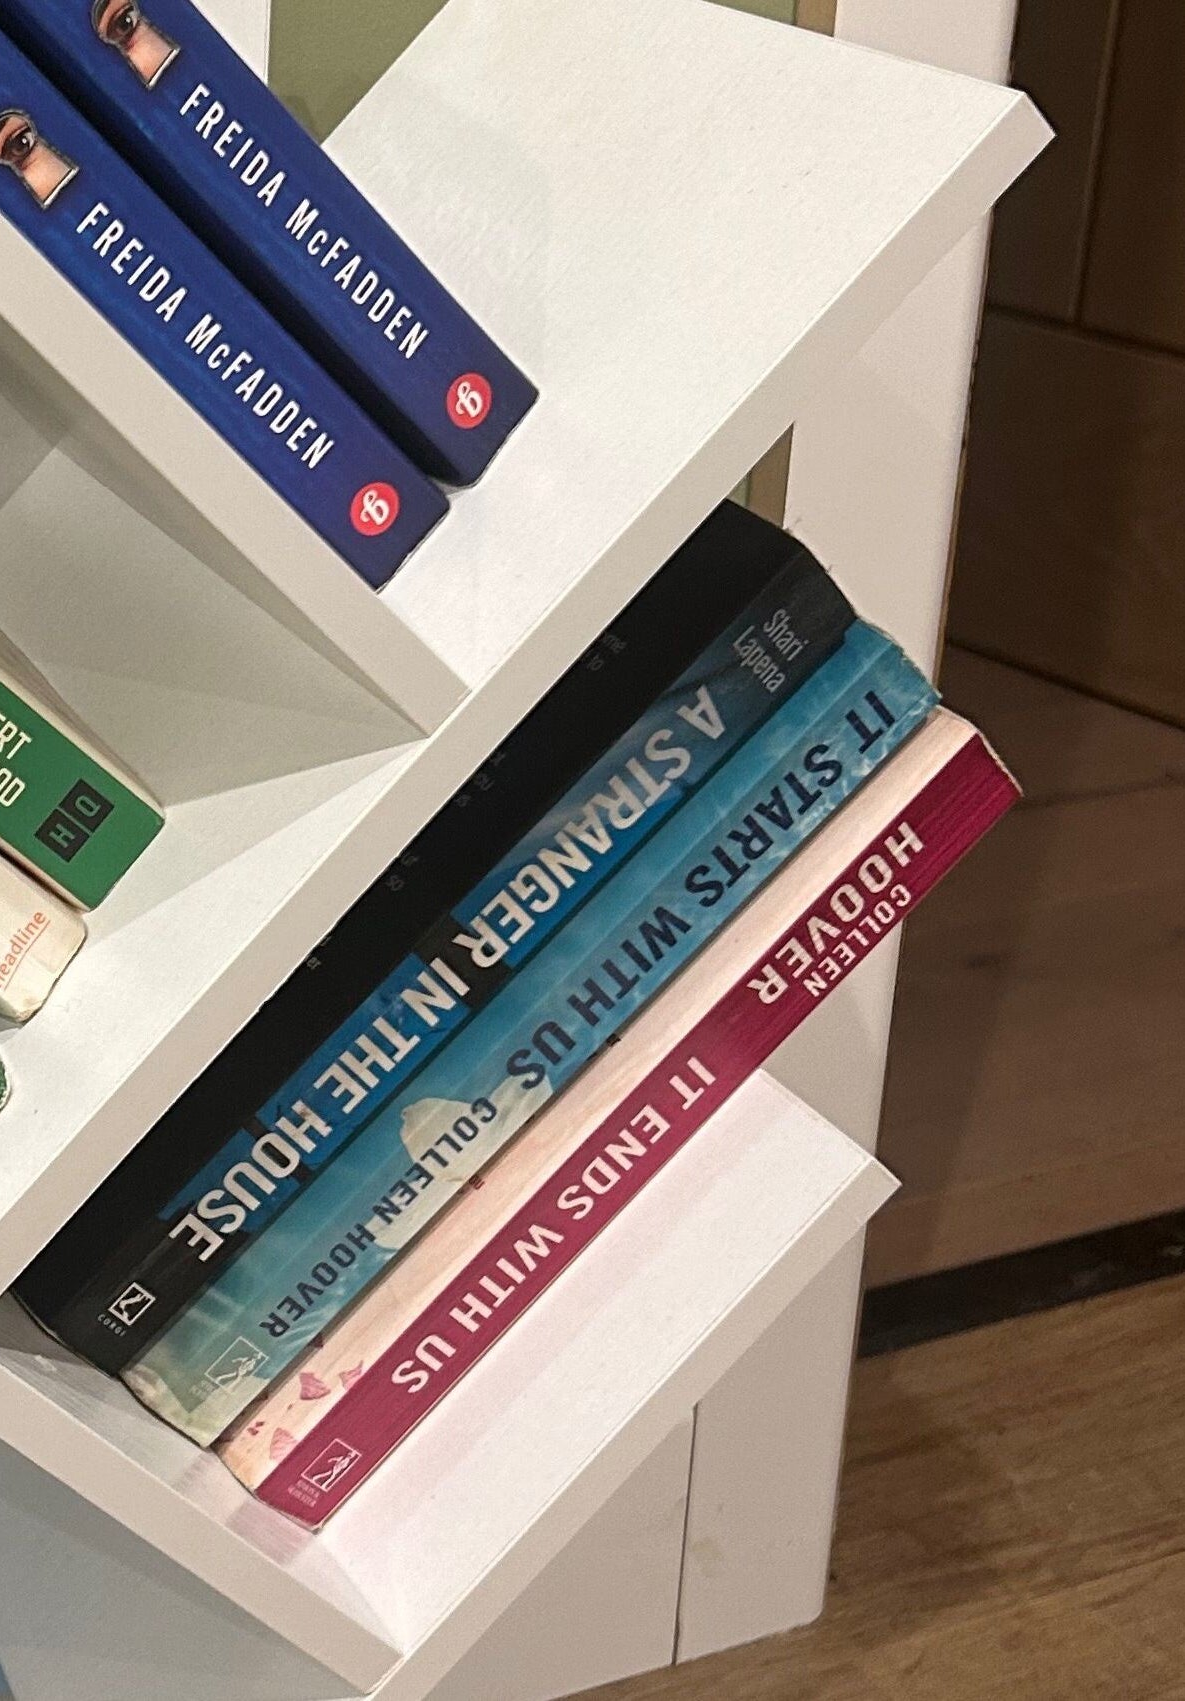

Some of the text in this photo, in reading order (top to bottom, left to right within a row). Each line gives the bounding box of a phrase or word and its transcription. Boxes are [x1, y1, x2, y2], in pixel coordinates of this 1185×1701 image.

[179, 83, 429, 360] FREIDA McFADDEN
[76, 202, 335, 470] FREIDA McFADDEN
[674, 683, 727, 740] A
[731, 624, 786, 694] Lapena
[761, 607, 806, 662] Shari
[451, 727, 693, 969] STRANGER
[506, 689, 896, 1091] IT STARTS WITH US
[746, 821, 926, 1007] HOOVER
[395, 955, 471, 1029] IN
[803, 883, 913, 999] COLLEEN
[311, 1018, 421, 1115] THE
[169, 1098, 332, 1264] HOUSE
[258, 1096, 499, 1339] COLLEEN HOOVER
[391, 1055, 716, 1395] IT ENDS WITH US
